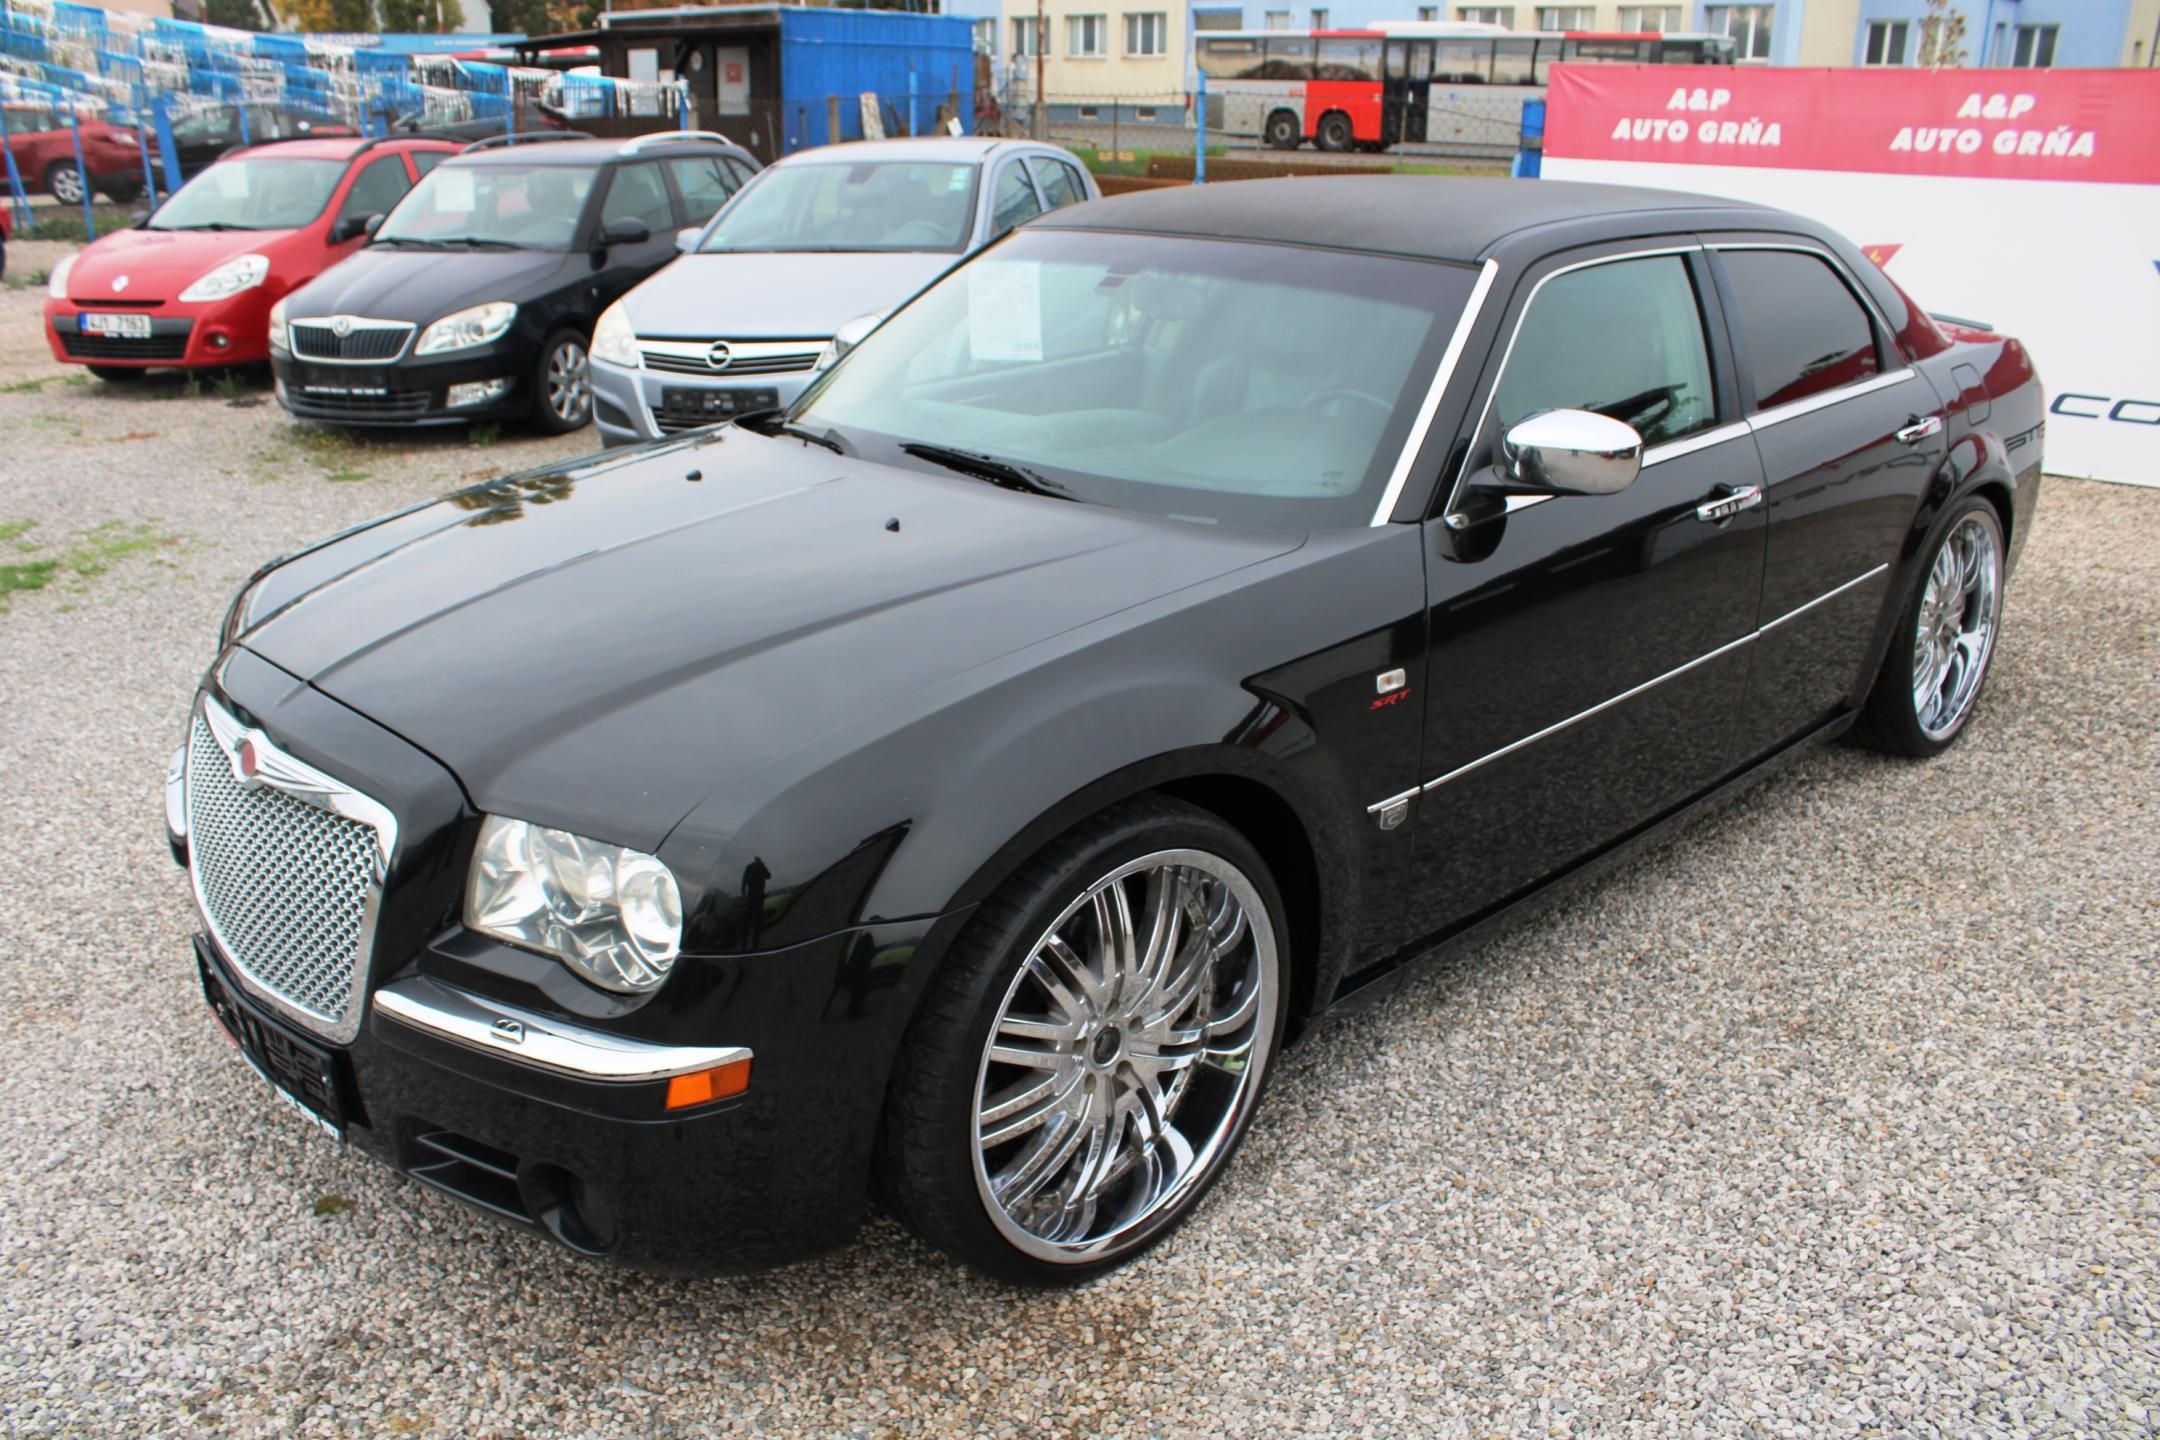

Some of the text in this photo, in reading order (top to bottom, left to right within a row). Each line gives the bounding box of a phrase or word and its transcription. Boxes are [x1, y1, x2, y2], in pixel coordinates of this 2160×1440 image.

[1666, 87, 1731, 111] A&P
[1956, 93, 2036, 119] A&P
[1611, 116, 1781, 146] AUTO GRŇA
[1889, 124, 2095, 157] AUTO GRŇA
[1370, 688, 1413, 711] SRT
